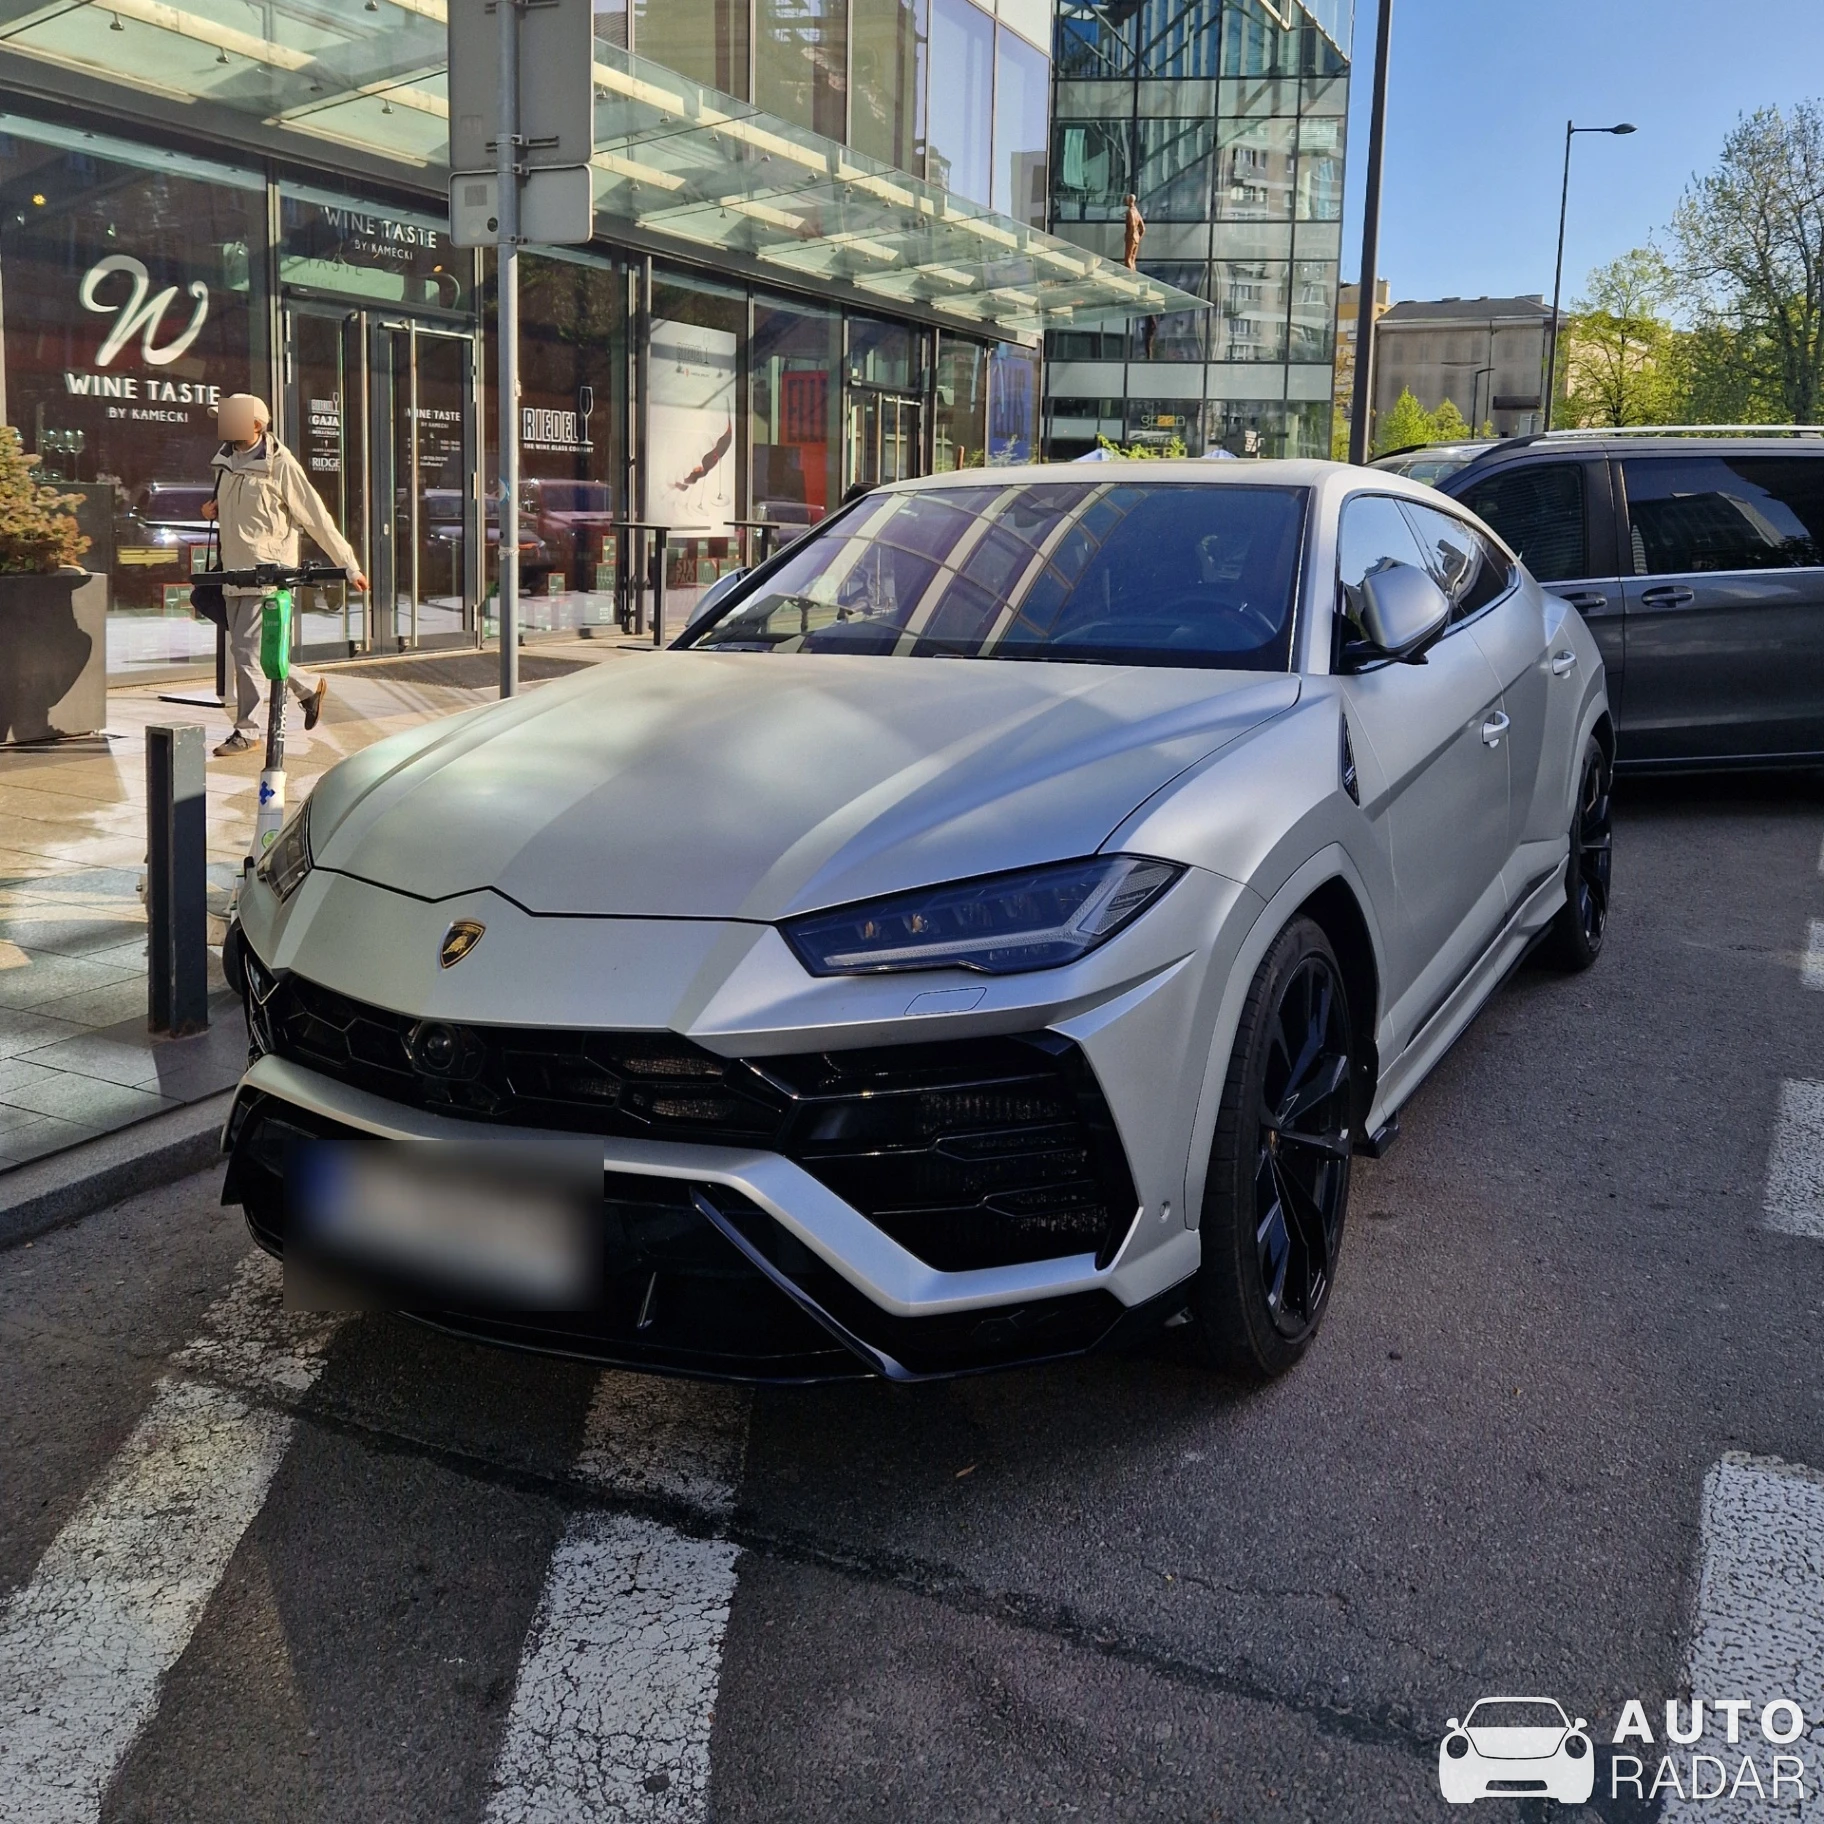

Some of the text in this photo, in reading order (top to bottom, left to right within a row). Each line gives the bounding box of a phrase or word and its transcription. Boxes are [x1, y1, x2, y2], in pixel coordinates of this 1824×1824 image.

[324, 206, 437, 249] WINE TASTE
[354, 239, 413, 260] BY KAMECKI
[66, 373, 221, 405] WINE TASTE
[108, 407, 189, 423] BY KAMECKI
[312, 415, 340, 427] GAJA
[433, 410, 461, 421] TASTE
[523, 407, 579, 443] RIEDEL
[535, 443, 550, 451] WINE
[312, 457, 341, 468] RIDGE
[676, 560, 695, 574] SIX
